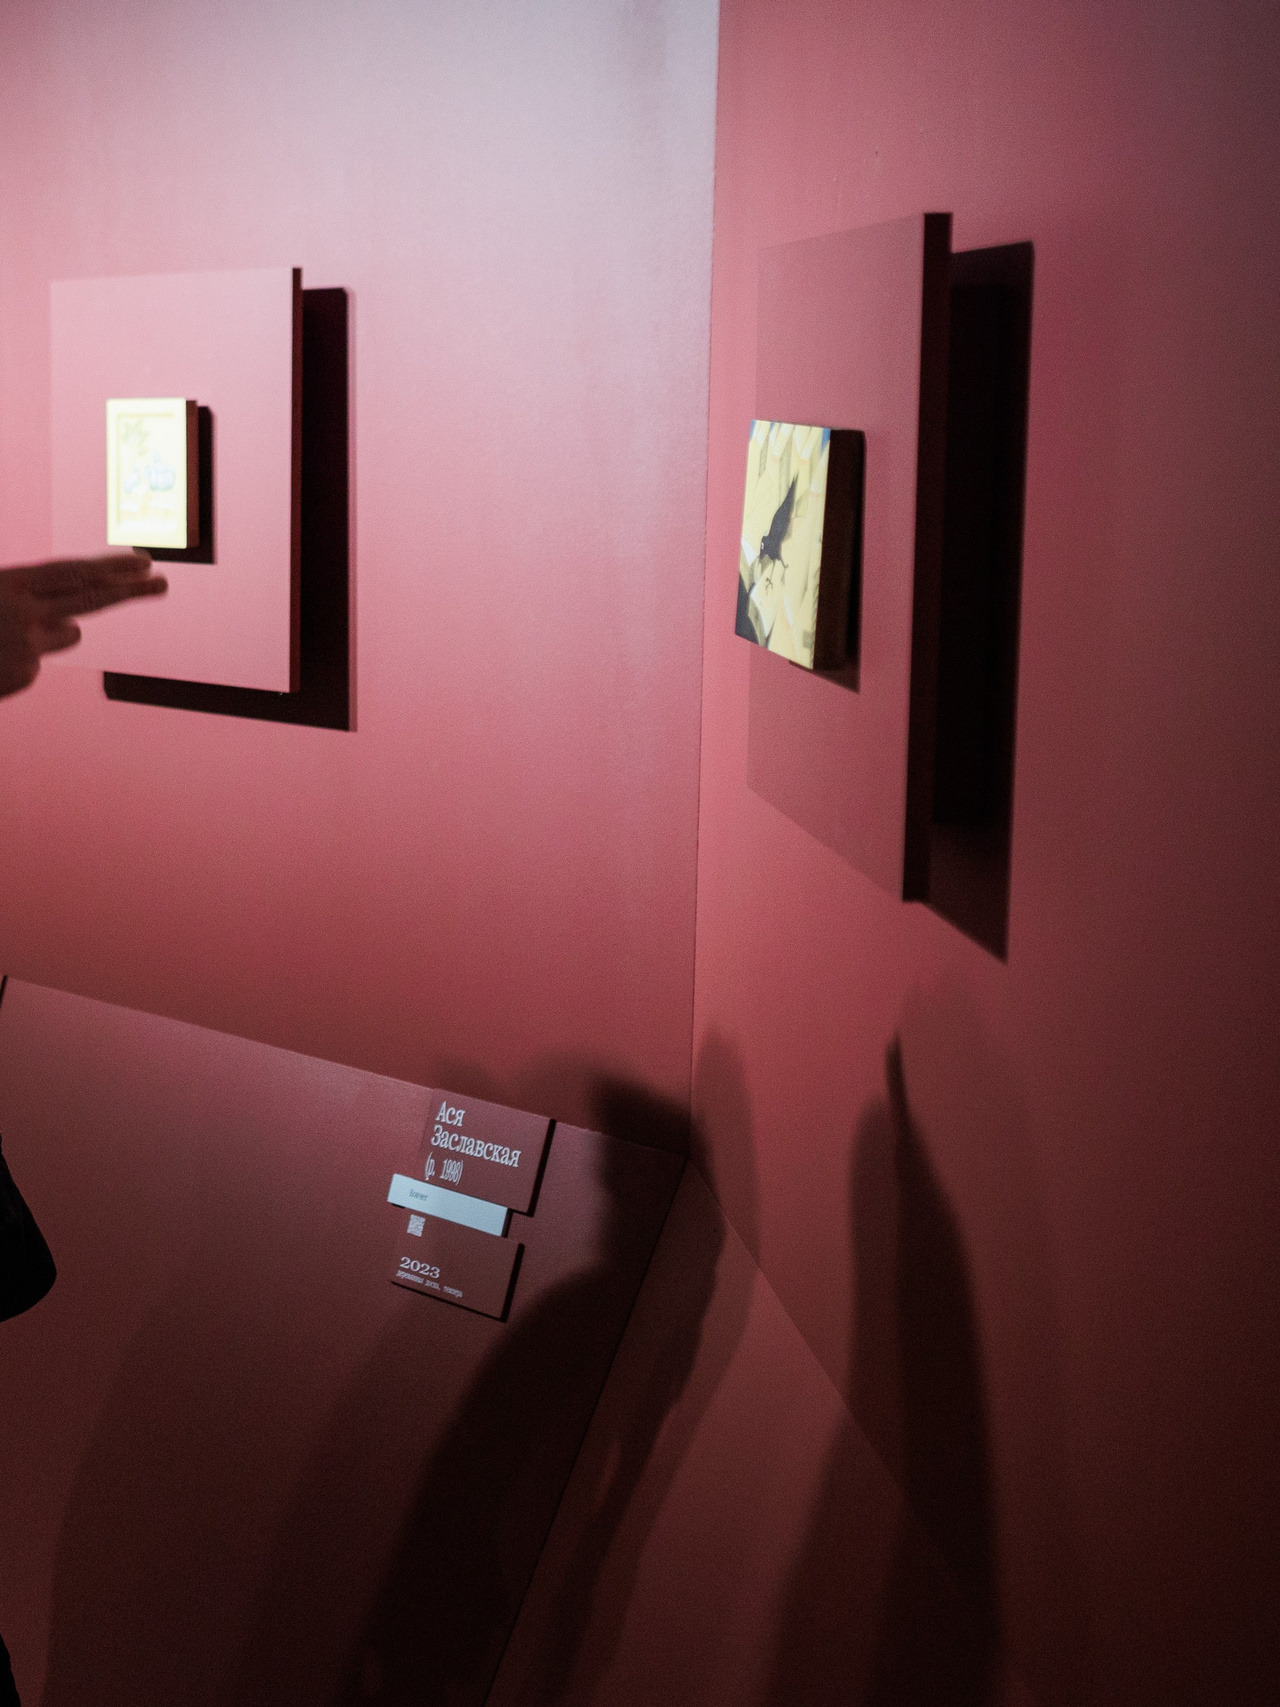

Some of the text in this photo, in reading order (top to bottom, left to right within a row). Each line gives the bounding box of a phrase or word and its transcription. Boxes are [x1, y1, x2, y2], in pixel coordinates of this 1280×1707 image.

[436, 1101, 465, 1126] Ася
[432, 1125, 521, 1167] Заславская
[399, 1257, 440, 1279] 2023
